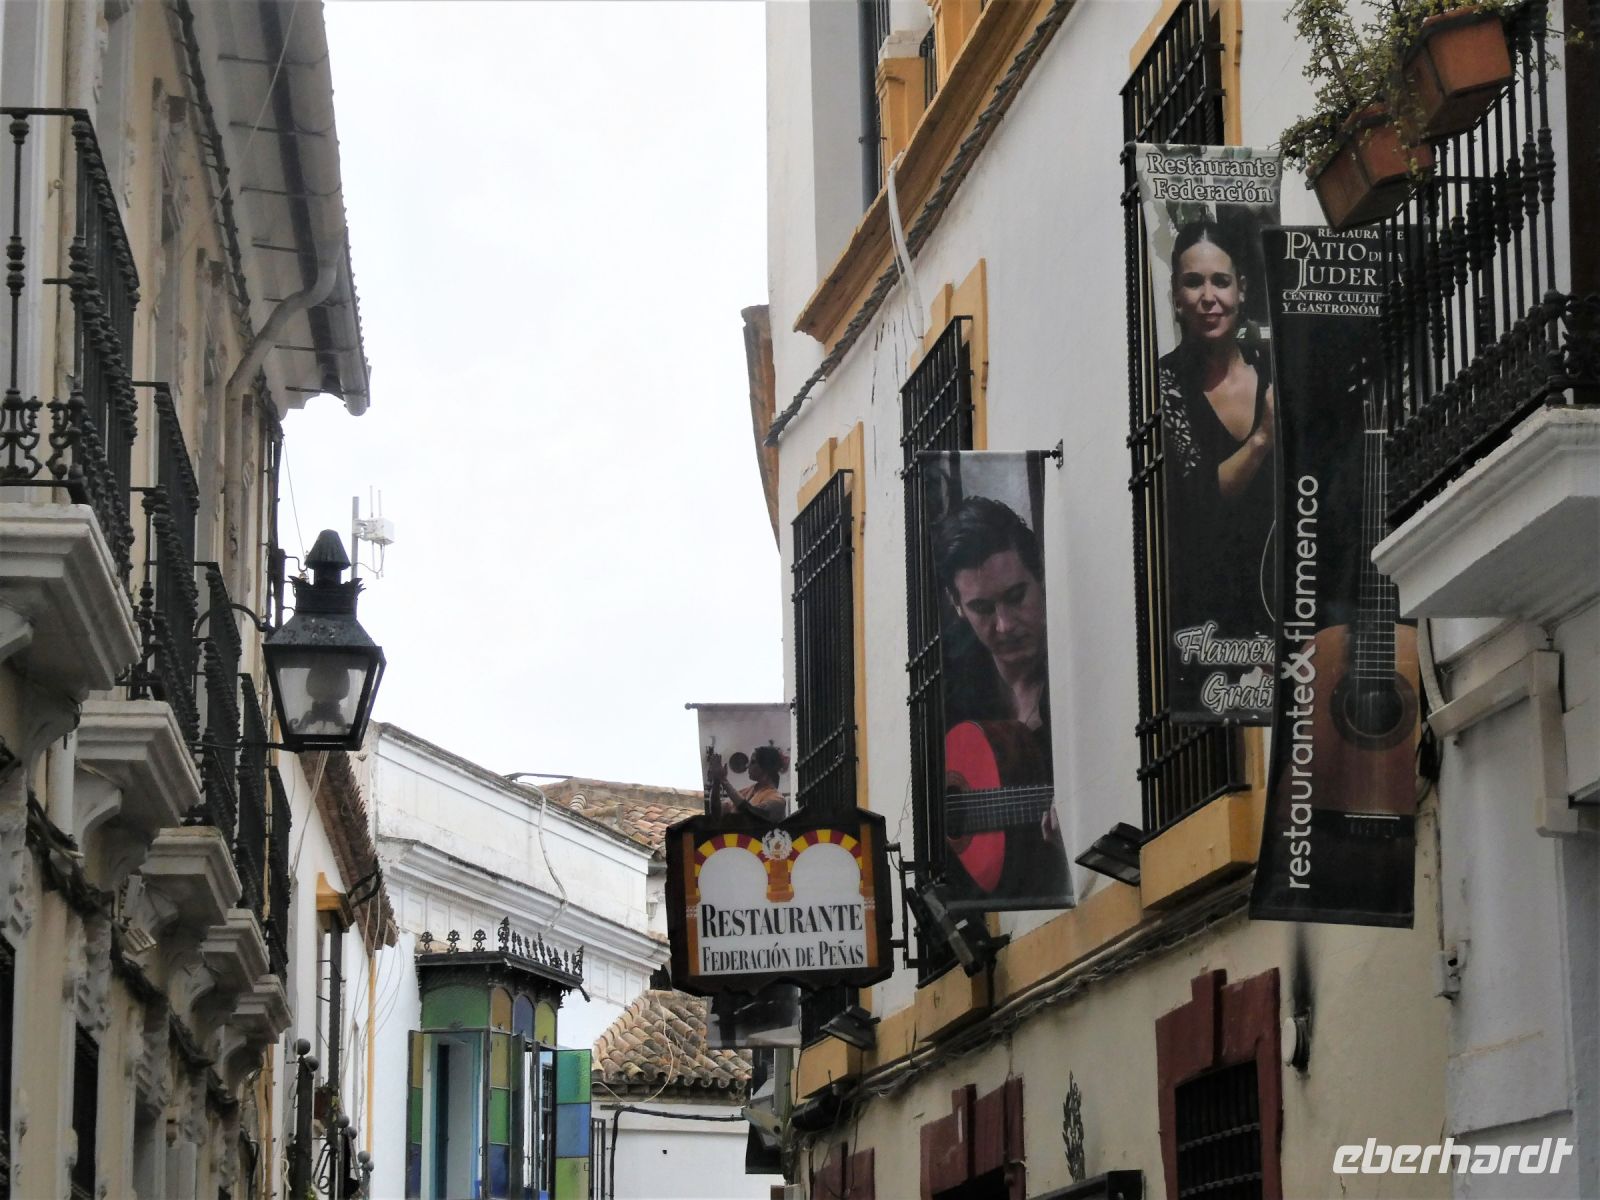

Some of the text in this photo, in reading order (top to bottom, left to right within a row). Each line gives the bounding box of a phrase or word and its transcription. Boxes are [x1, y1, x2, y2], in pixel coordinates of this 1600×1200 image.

[1146, 153, 1277, 177] Restaurante
[1153, 178, 1273, 202] Federación
[1283, 231, 1367, 261] PATIO
[1282, 291, 1380, 304] CENTRO CULTU
[1282, 302, 1380, 315] Y GASTRONÓM
[1174, 621, 1275, 664] Flamen
[1202, 672, 1273, 714] Grati
[701, 903, 864, 938] RESTAURANTE
[702, 939, 864, 973] FEDERACIÓN DE PEÑAS
